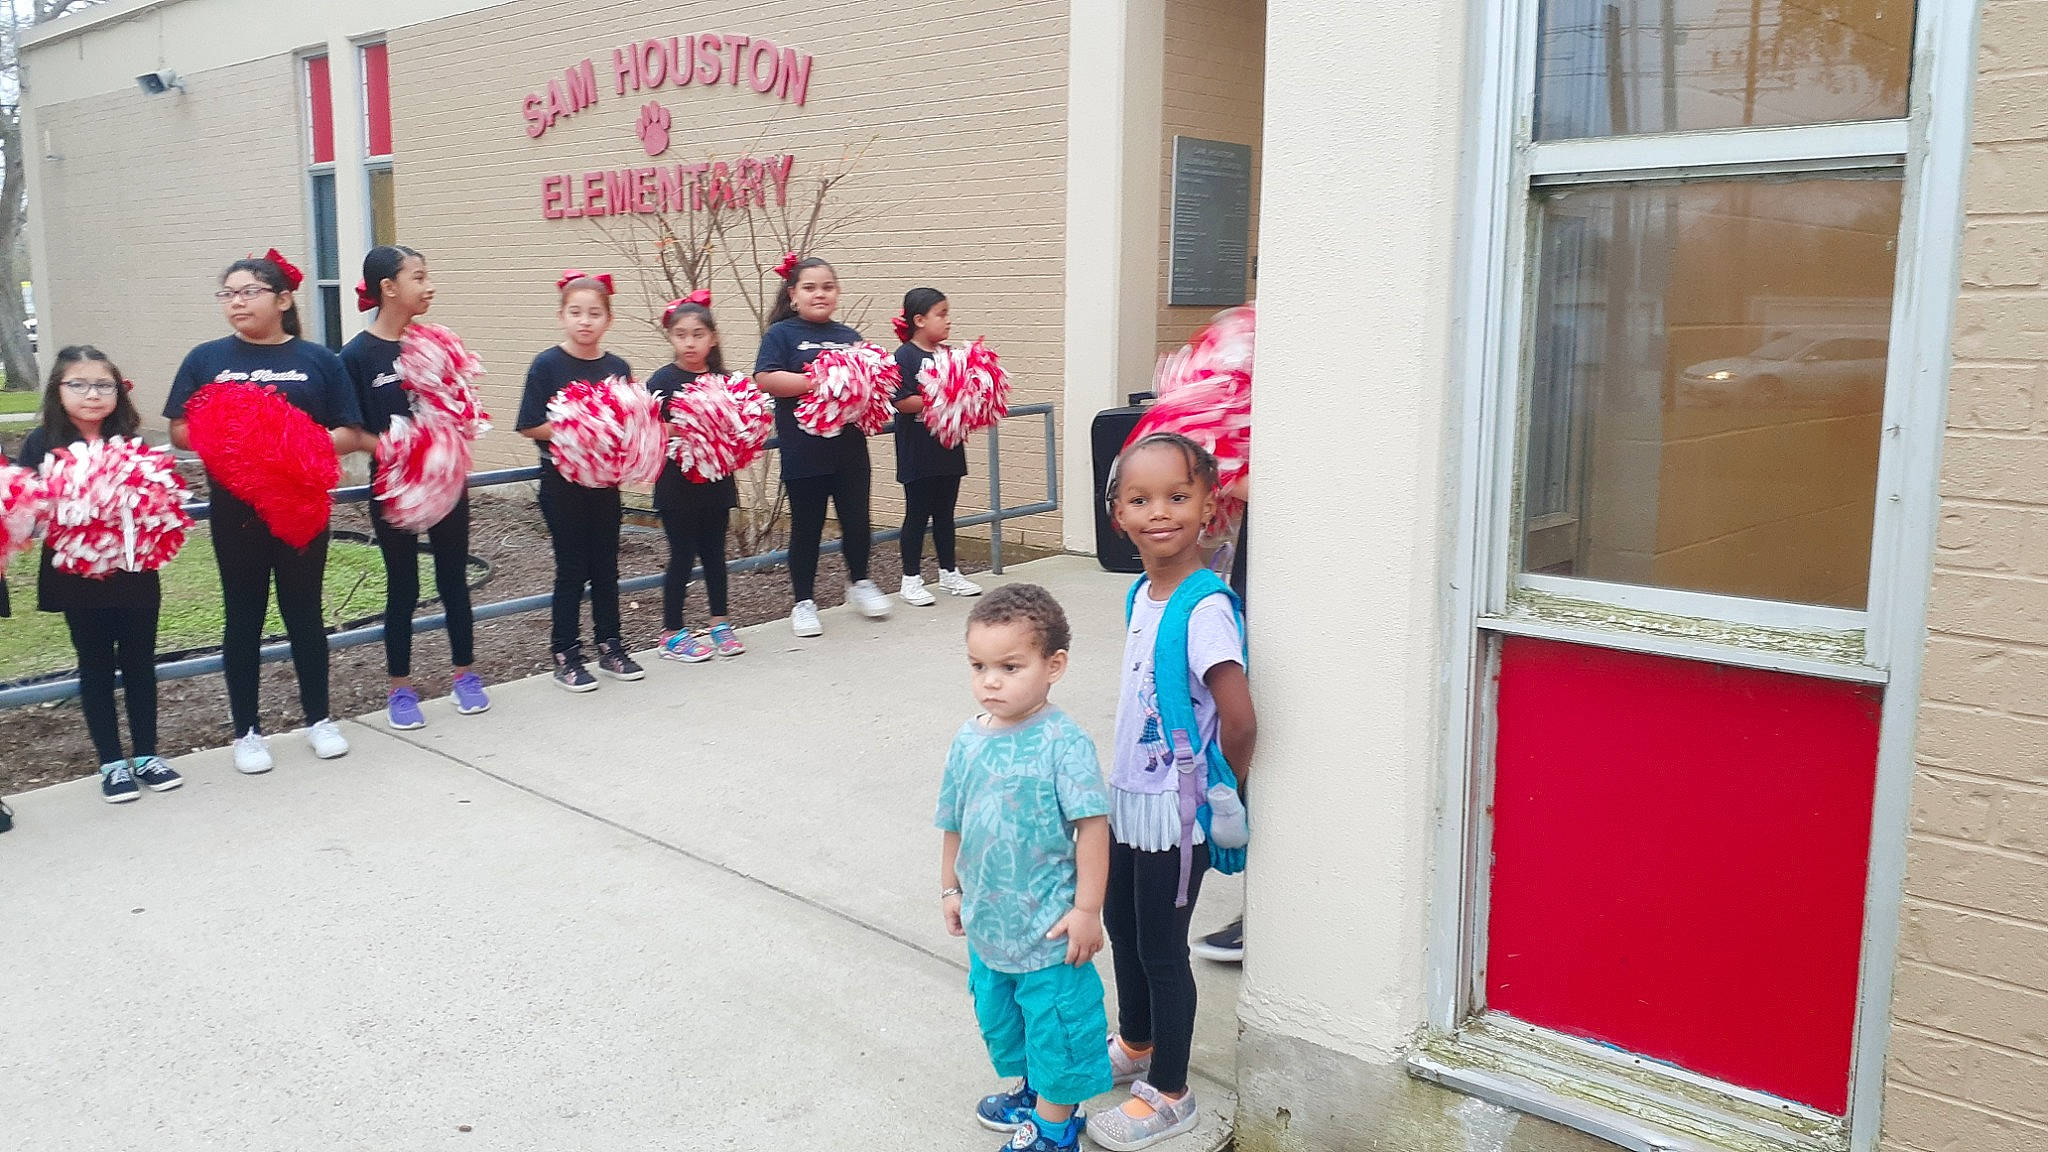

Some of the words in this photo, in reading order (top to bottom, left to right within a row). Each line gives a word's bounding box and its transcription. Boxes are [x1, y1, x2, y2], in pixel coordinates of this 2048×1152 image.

[522, 58, 598, 138] SAM
[613, 34, 812, 106] HOUSTON
[542, 155, 794, 219] ELEMENTARY
